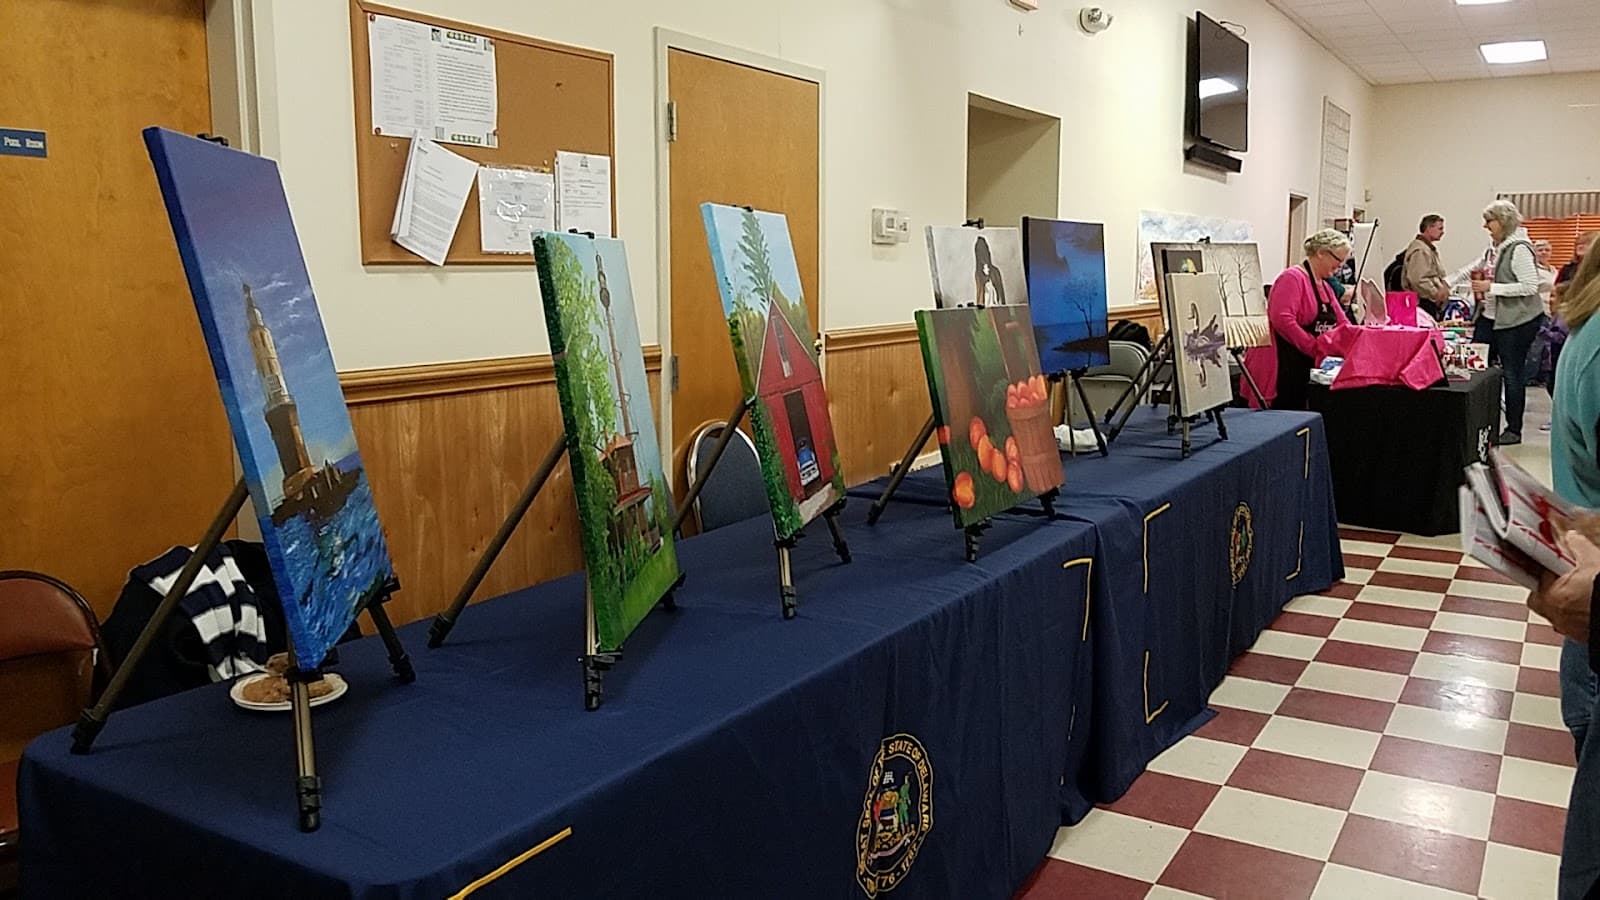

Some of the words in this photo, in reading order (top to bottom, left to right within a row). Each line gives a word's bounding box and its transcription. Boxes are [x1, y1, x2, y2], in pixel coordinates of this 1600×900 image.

[888, 740, 914, 755] STATE
[911, 747, 922, 761] OF
[917, 758, 930, 831] DELAWARE
